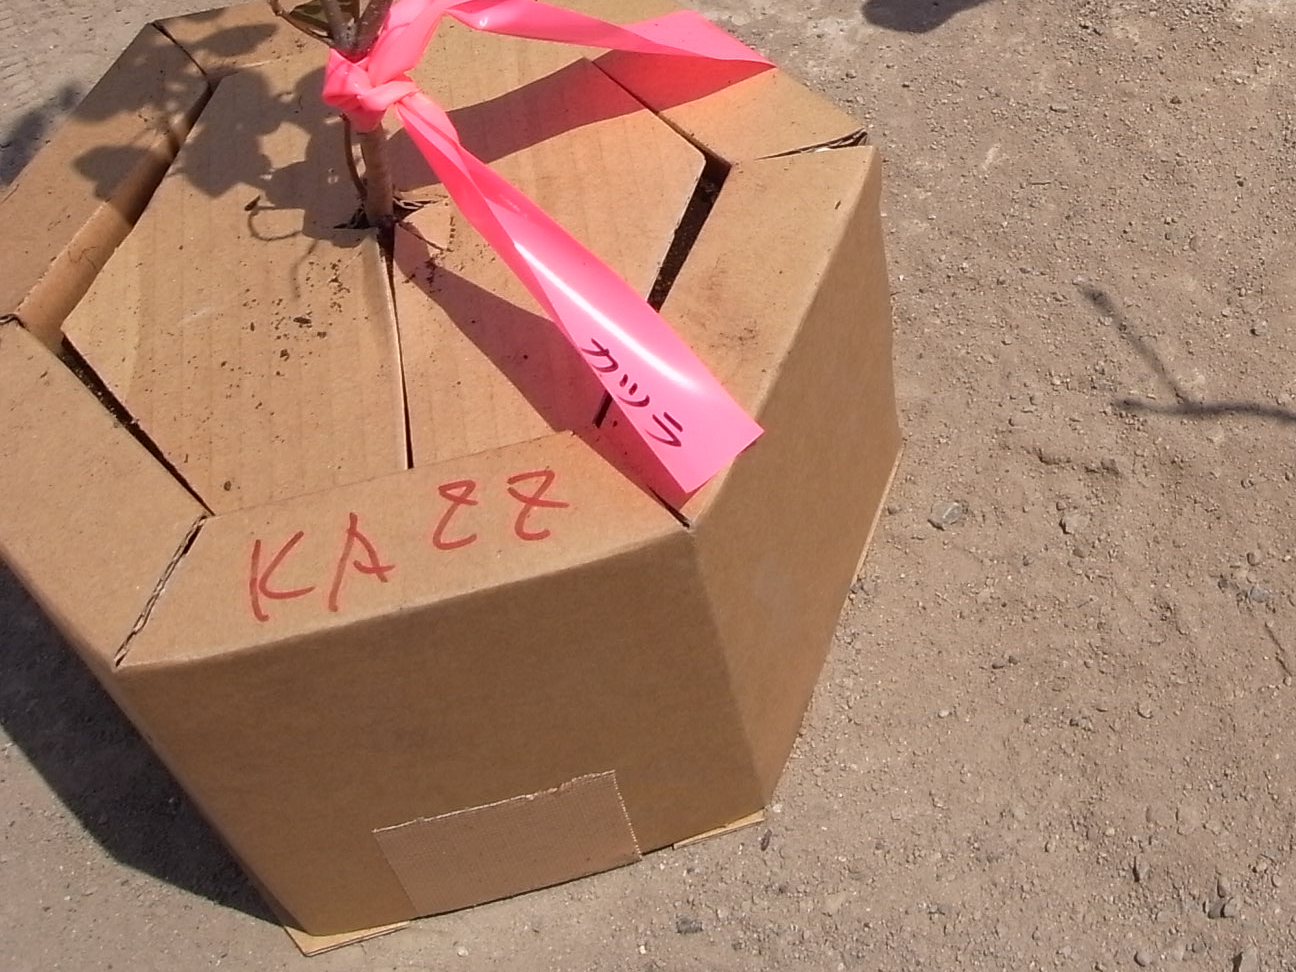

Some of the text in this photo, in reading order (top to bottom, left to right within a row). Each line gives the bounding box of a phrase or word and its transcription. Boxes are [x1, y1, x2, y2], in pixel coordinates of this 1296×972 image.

[580, 337, 683, 447] カツラ
[250, 470, 569, 622] KAZZ
